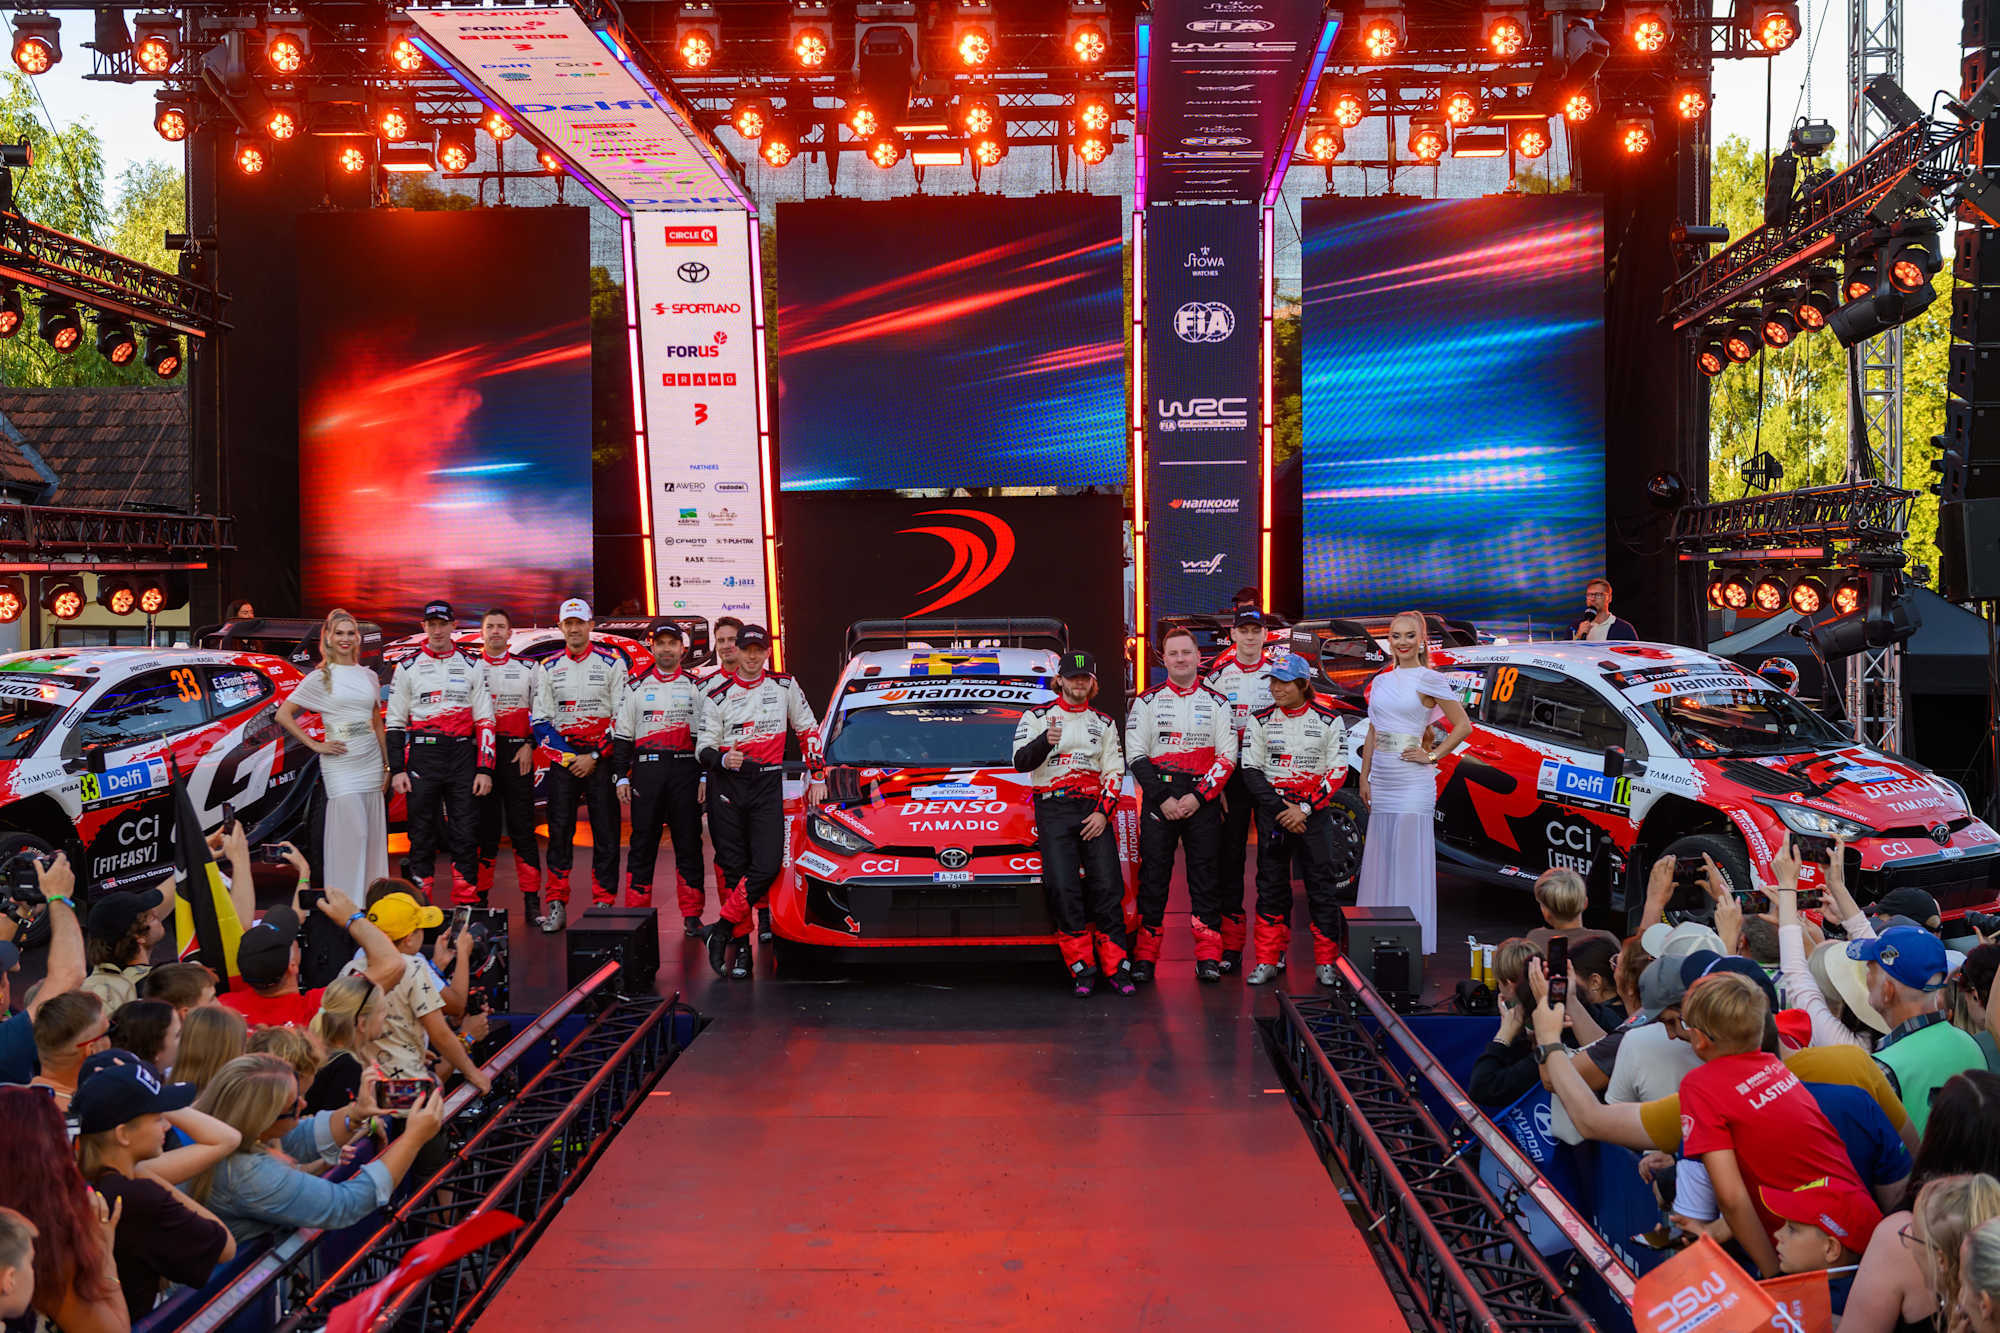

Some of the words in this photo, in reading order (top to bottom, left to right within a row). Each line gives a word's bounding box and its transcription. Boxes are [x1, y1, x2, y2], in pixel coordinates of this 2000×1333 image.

[669, 231, 699, 239] CIRCLE
[1183, 252, 1225, 268] STOWA
[671, 303, 741, 314] SPORTLAND
[667, 345, 720, 358] FORUS
[664, 374, 735, 385] CRAMO
[1158, 397, 1248, 417] WRC
[676, 482, 706, 490] AWERO
[1181, 498, 1240, 509] Hankook
[721, 602, 750, 611] Agenda
[170, 667, 202, 704] 33
[895, 679, 948, 688] TOYOTA
[1000, 679, 1045, 689] Racing
[1491, 666, 1520, 703] 18
[906, 688, 1034, 700] Hankook
[21, 768, 63, 785] TAMADIC
[107, 768, 144, 791] Delfi
[1565, 771, 1605, 794] Delfi
[1649, 769, 1694, 787] TAMADIC
[61, 783, 80, 793] PIAA
[80, 772, 101, 803] 33
[1631, 785, 1652, 795] PIAA
[1861, 778, 1932, 800] DENSO
[900, 801, 1009, 816] DENSO
[1806, 799, 1868, 822] codebeamer
[1887, 797, 1946, 814] TAMADIC
[833, 809, 874, 836] codebeamer
[908, 820, 1001, 832] TAMADIC
[782, 815, 796, 868] Panasonic
[1116, 809, 1128, 862] Panasonic
[1127, 808, 1139, 865] AUTOMOTIVE
[1728, 810, 1767, 866] AUTOMOTIVE
[1881, 841, 1913, 857] CCI
[861, 859, 900, 873] CCI
[1009, 857, 1042, 870] CC
[115, 873, 147, 886] TOYOTA
